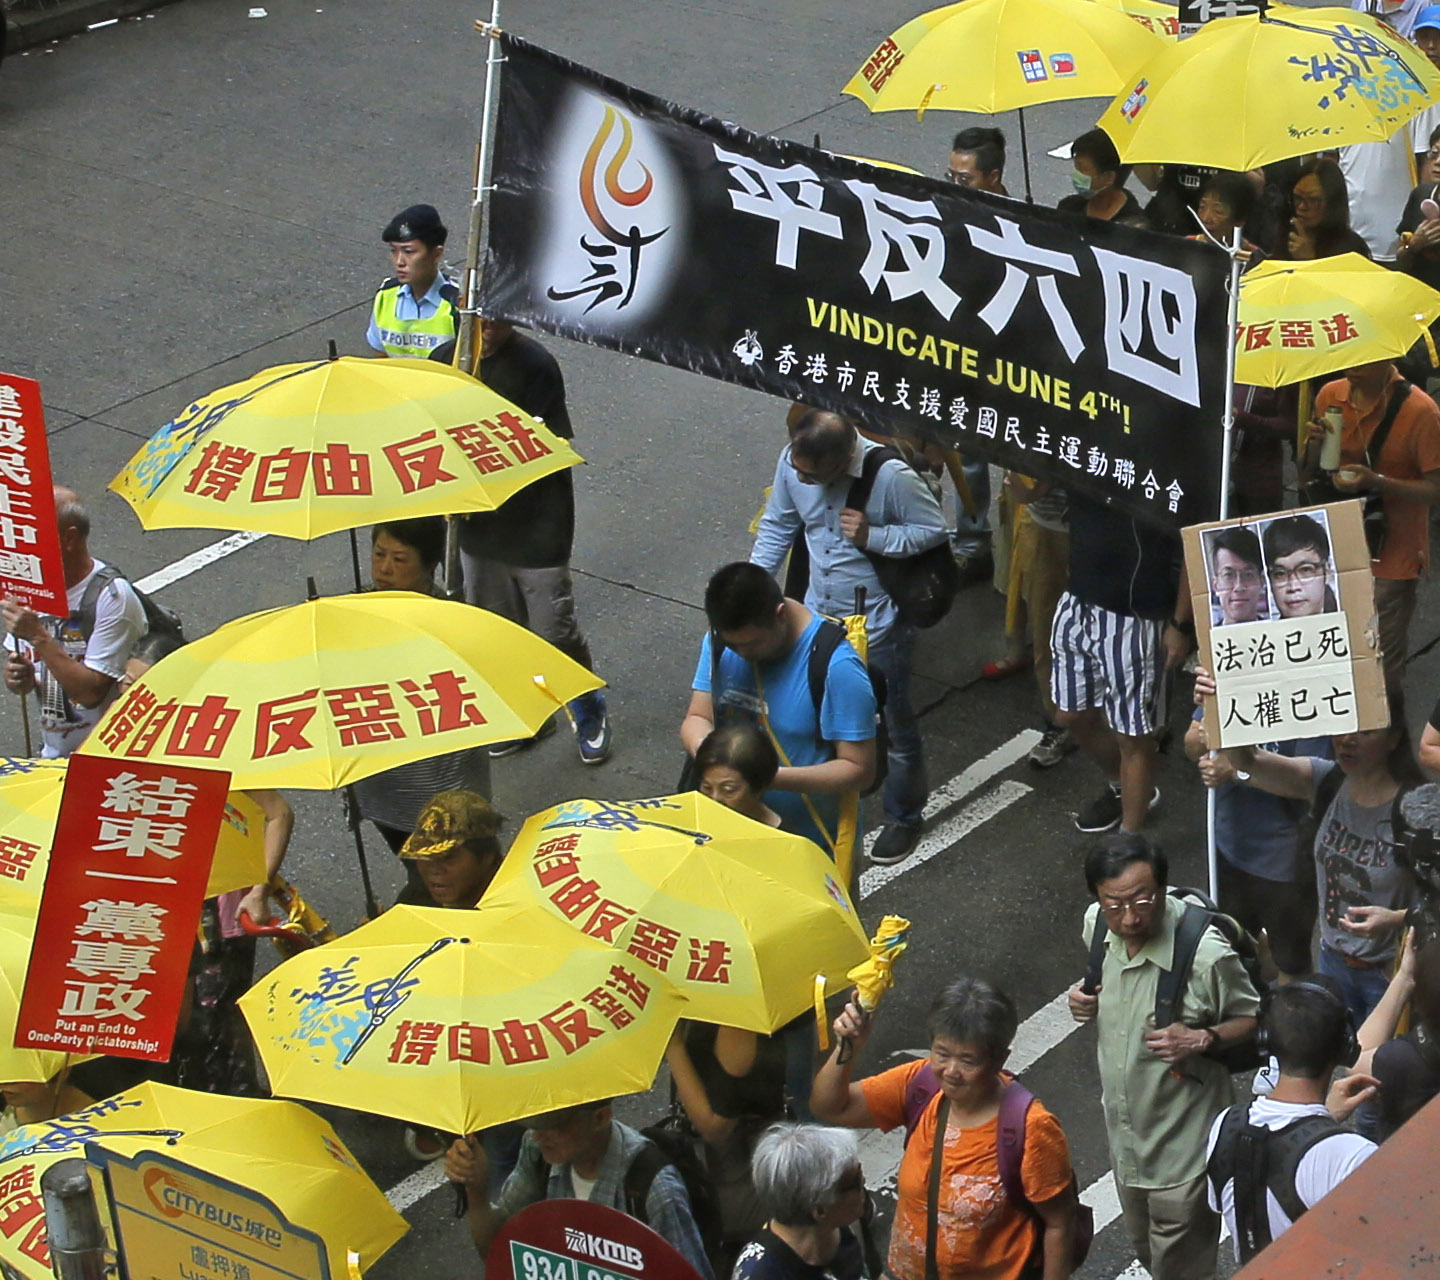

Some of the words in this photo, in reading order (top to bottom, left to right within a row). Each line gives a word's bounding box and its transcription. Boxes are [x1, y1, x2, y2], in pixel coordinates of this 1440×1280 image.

[713, 142, 1200, 408] 平反六四
[390, 333, 423, 347] POLICE
[805, 298, 981, 379] VINDICATE
[987, 362, 1071, 411] JUNE
[185, 410, 552, 502] 撐自由反惡法
[775, 344, 1186, 514] 香港市民支援愛國民主運動聯合會
[7, 581, 54, 599] Democratic
[1215, 625, 1349, 673] 法治已死
[99, 671, 489, 760] 撐自由反惡法
[1222, 686, 1353, 731] 人權已亡
[60, 771, 196, 1021] 結束一黨專政
[536, 832, 733, 984] 撐自由反惡法
[26, 1029, 84, 1046] One-Party
[85, 1032, 159, 1054] Dictatorship!
[55, 1019, 76, 1032] Put
[78, 1021, 93, 1033] an
[96, 1022, 120, 1036] End
[123, 1024, 136, 1037] to
[387, 963, 652, 1066] 撐自由反惡法
[163, 1186, 243, 1233] CITYBUS
[245, 1220, 282, 1249] 城巴
[587, 1235, 644, 1271] KMB
